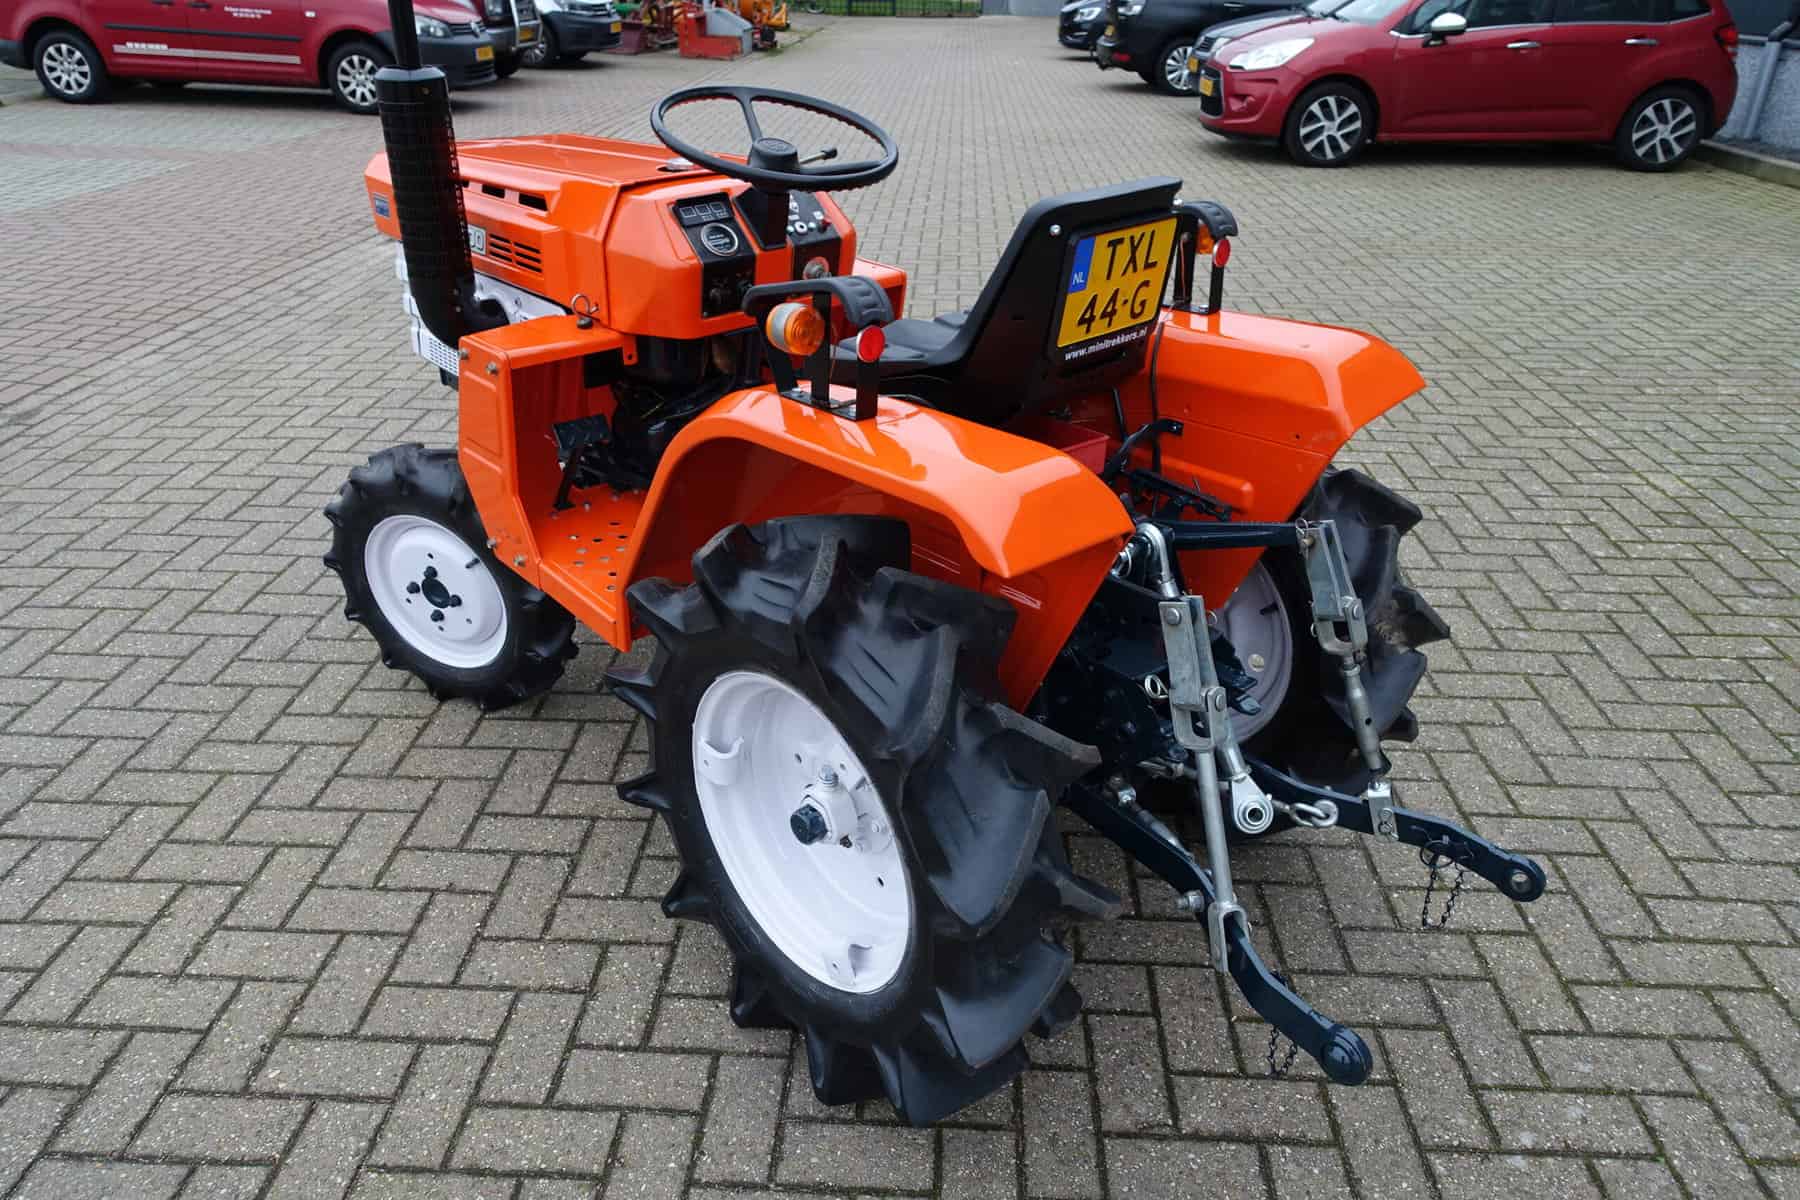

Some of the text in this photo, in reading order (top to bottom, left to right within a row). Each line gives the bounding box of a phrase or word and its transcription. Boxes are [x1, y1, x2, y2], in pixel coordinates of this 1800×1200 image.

[1107, 229, 1158, 280] TXL
[1072, 272, 1085, 285] NL
[1065, 327, 1148, 361] www.minitrekkers.nl
